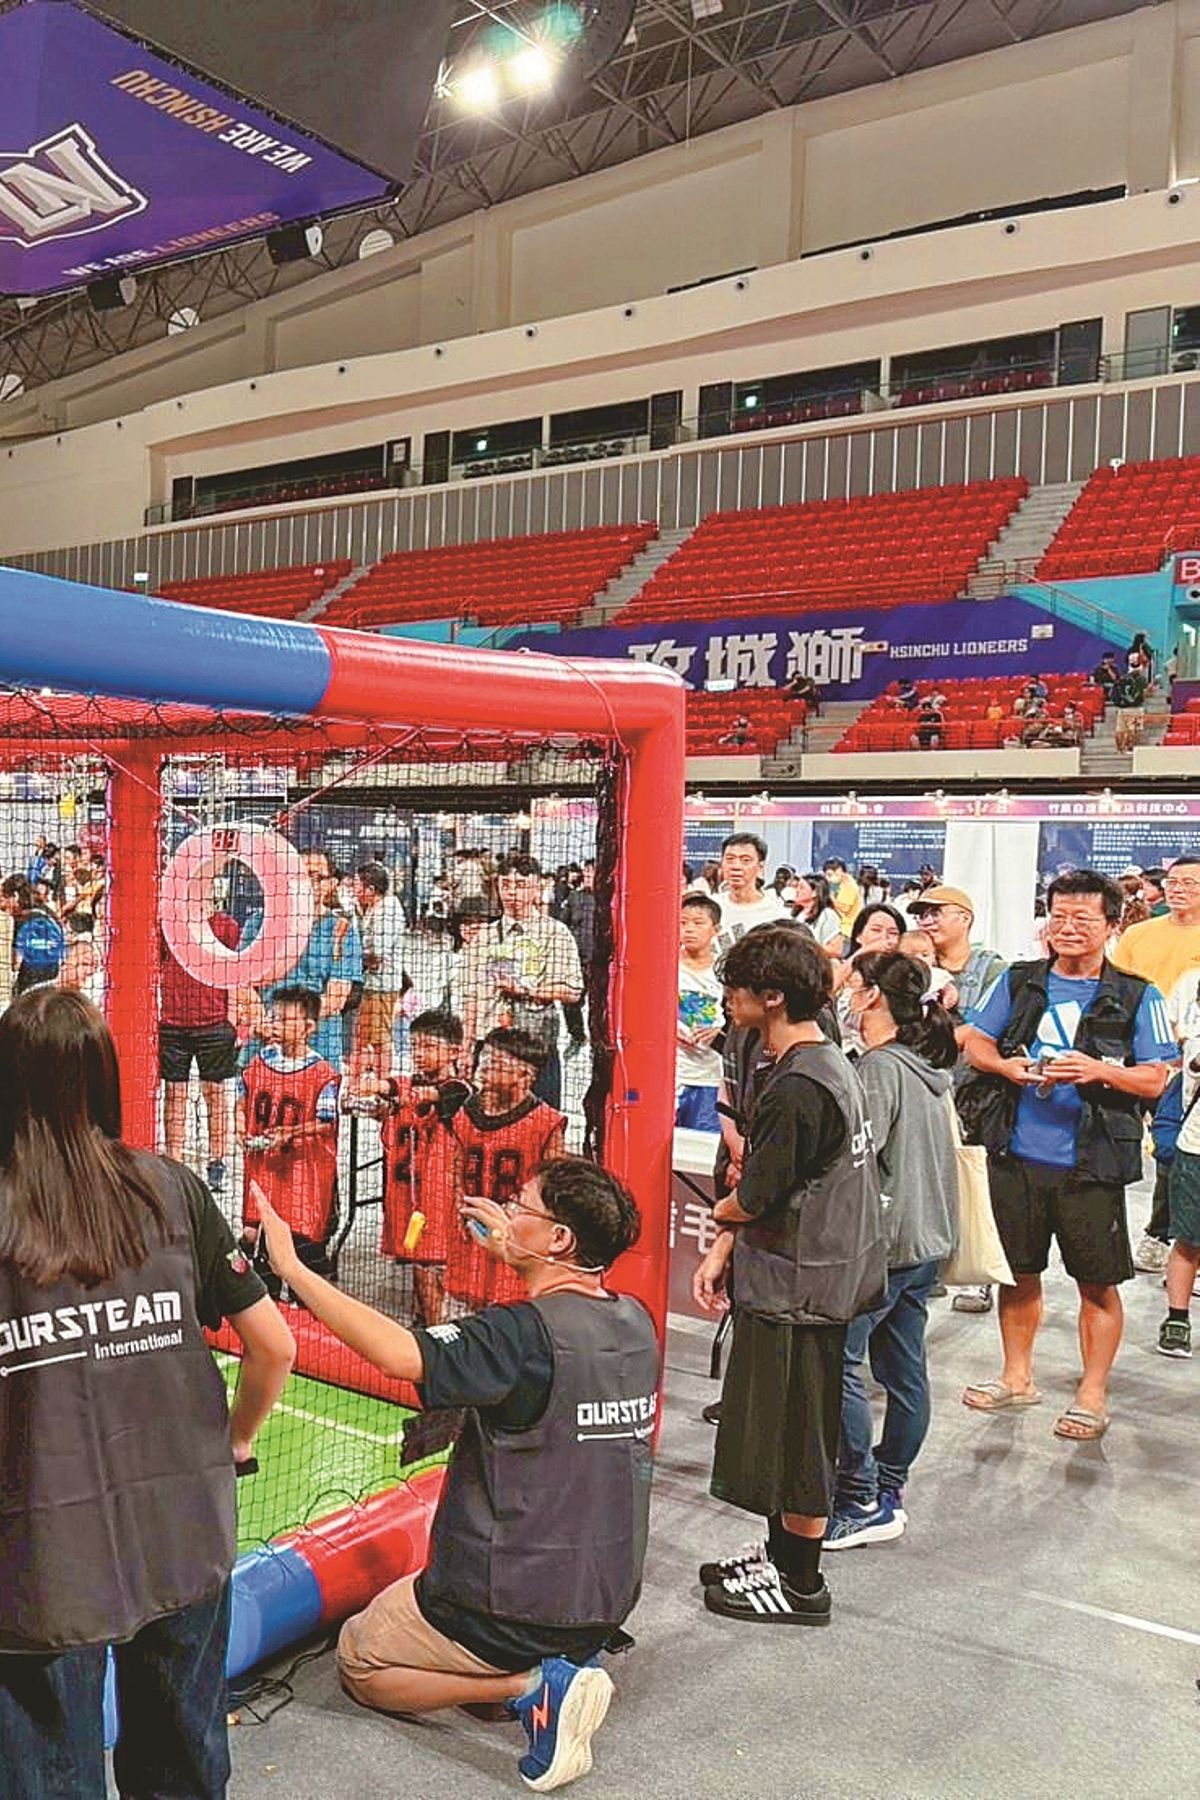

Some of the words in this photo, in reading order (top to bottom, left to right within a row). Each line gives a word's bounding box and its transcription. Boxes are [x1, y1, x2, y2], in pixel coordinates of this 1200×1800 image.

[109, 69, 236, 133] HSINCHU
[218, 122, 274, 155] ARE
[263, 144, 312, 174] WE
[890, 642, 951, 659] HSINCHU
[953, 638, 1028, 657] LIONEERS
[94, 1328, 183, 1360] International
